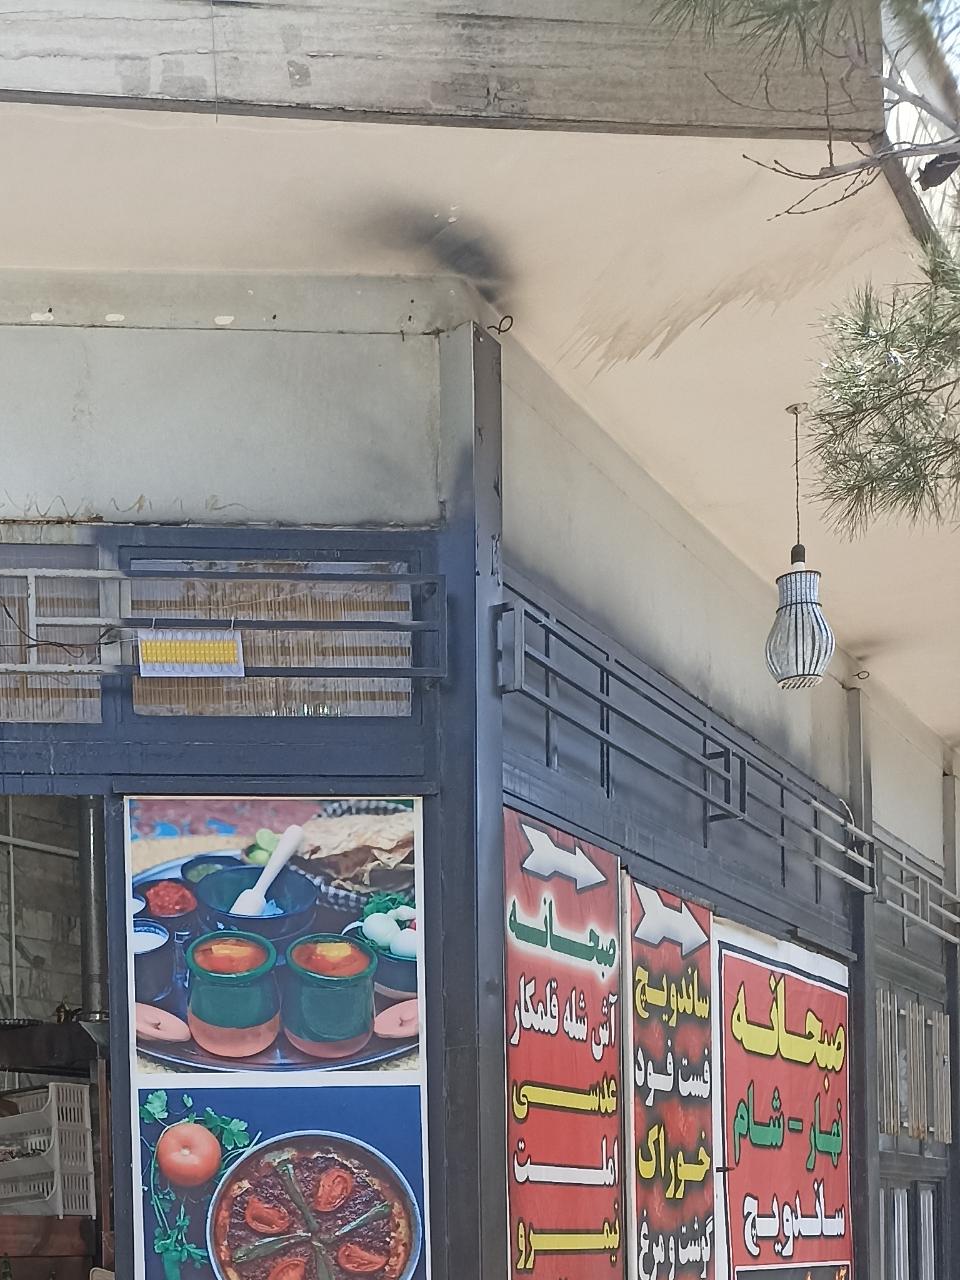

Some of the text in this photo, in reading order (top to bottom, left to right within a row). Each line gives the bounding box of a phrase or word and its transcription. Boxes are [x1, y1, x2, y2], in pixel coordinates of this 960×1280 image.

[508, 897, 617, 979] صبحانه
[510, 975, 617, 1061] آش شله قلمکار
[635, 965, 710, 1027] ساندویچ
[730, 971, 846, 1094] صبحانه
[512, 1076, 617, 1120] عدسی
[635, 1039, 711, 1107] فست فود
[733, 1079, 785, 1167] شام
[806, 1093, 843, 1171] نهار
[513, 1136, 619, 1187] املت
[638, 1123, 711, 1199] خوراک
[516, 1201, 620, 1270] نیمرو
[678, 1216, 714, 1279] گوشت
[743, 1178, 846, 1258] ساندویچ
[668, 1235, 675, 1280] و
